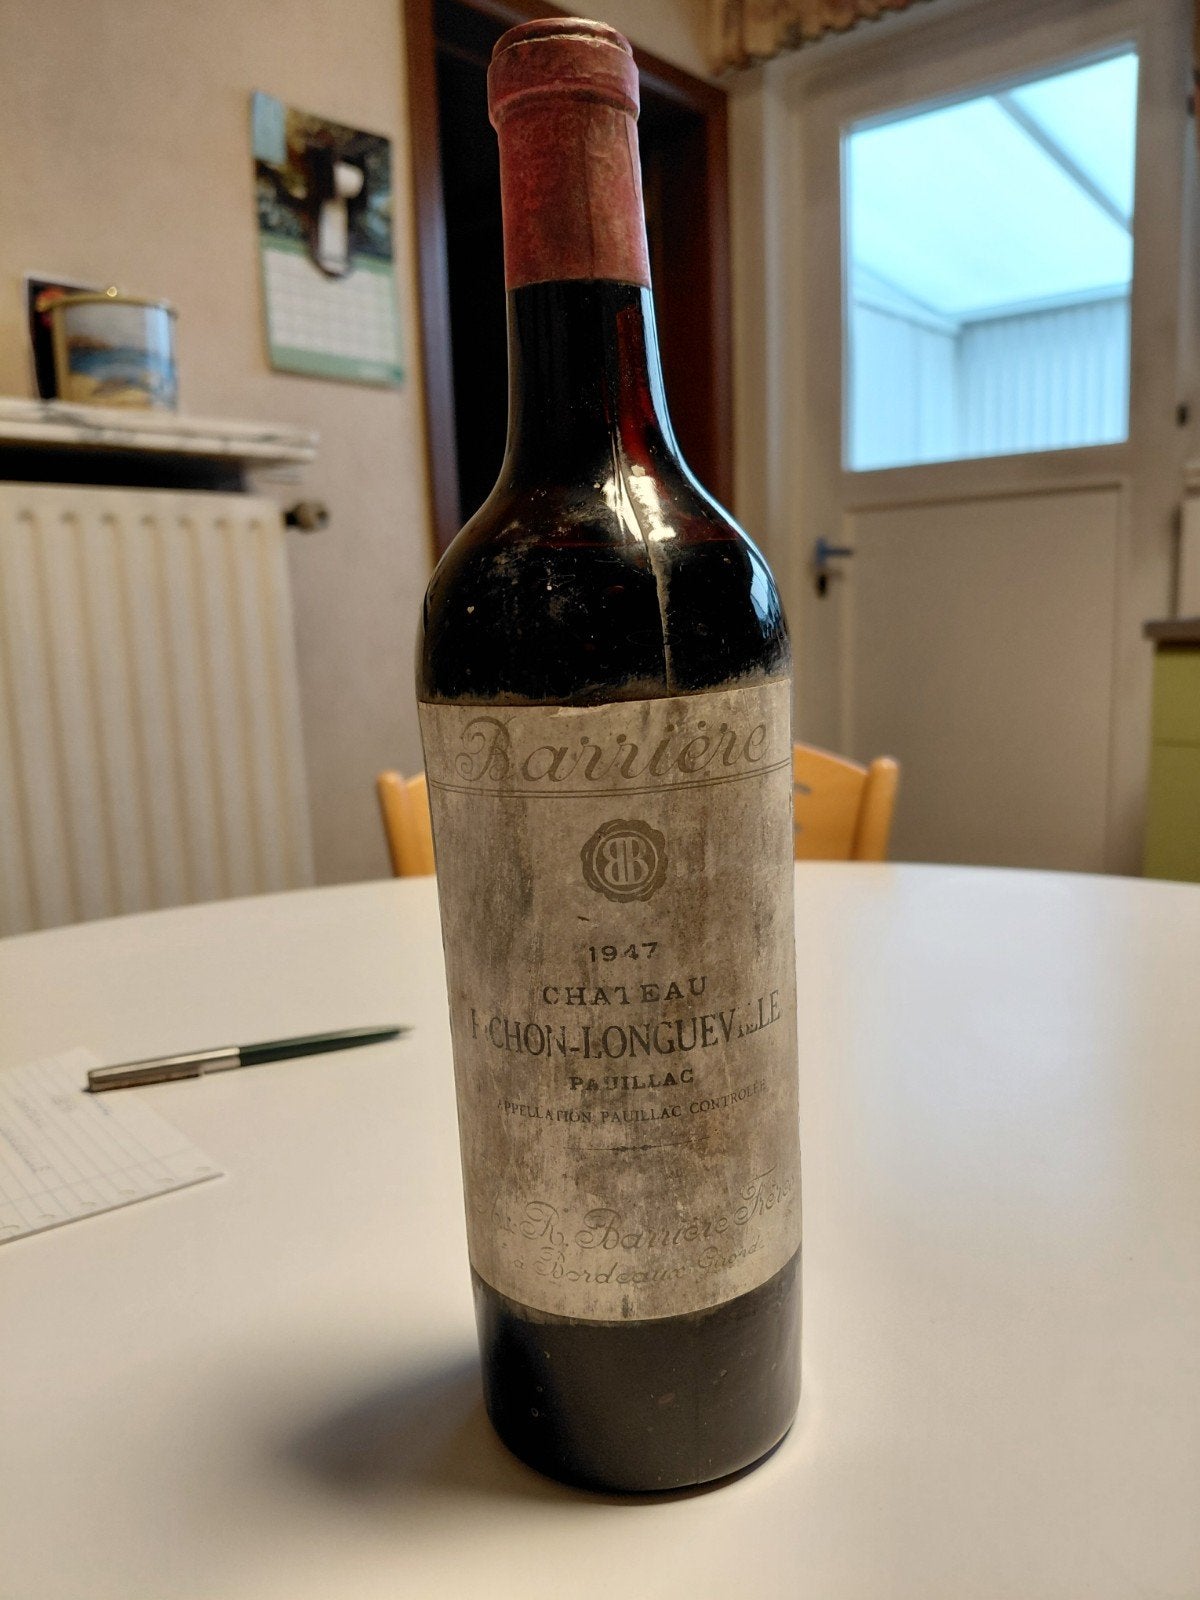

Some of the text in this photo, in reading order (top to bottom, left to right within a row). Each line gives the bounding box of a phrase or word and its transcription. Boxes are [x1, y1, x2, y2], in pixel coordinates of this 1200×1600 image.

[455, 715, 767, 783] Barrière
[589, 941, 658, 962] 1947
[542, 976, 707, 1006] CHATEAU
[470, 989, 781, 1059] PCHON-LONGUEVLE
[569, 1068, 694, 1091] PAUILLAC
[600, 1106, 682, 1123] PAUILLAC
